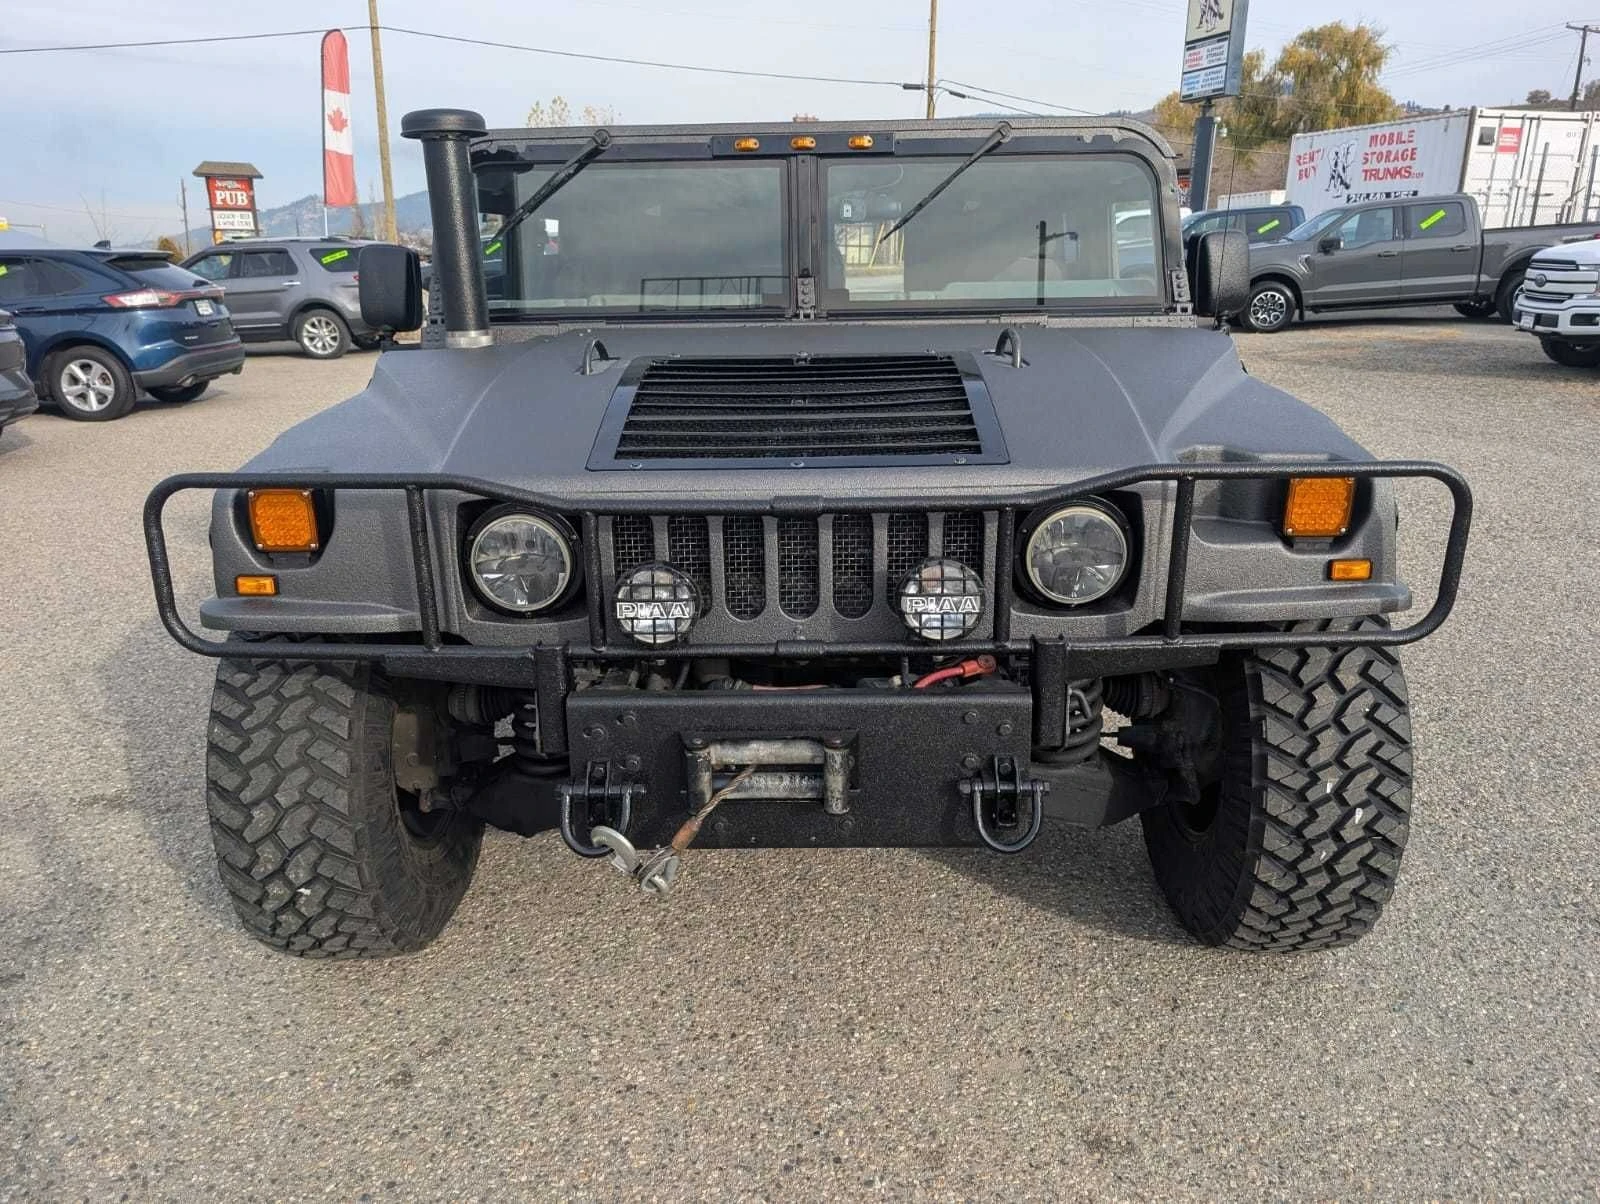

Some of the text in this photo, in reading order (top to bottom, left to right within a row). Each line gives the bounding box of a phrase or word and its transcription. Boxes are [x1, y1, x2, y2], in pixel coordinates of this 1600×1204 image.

[1368, 129, 1416, 148] MOBILE
[1362, 147, 1418, 165] STORAGE
[214, 190, 249, 206] PUB
[617, 602, 690, 619] PIAA
[907, 596, 979, 614] PIAA
